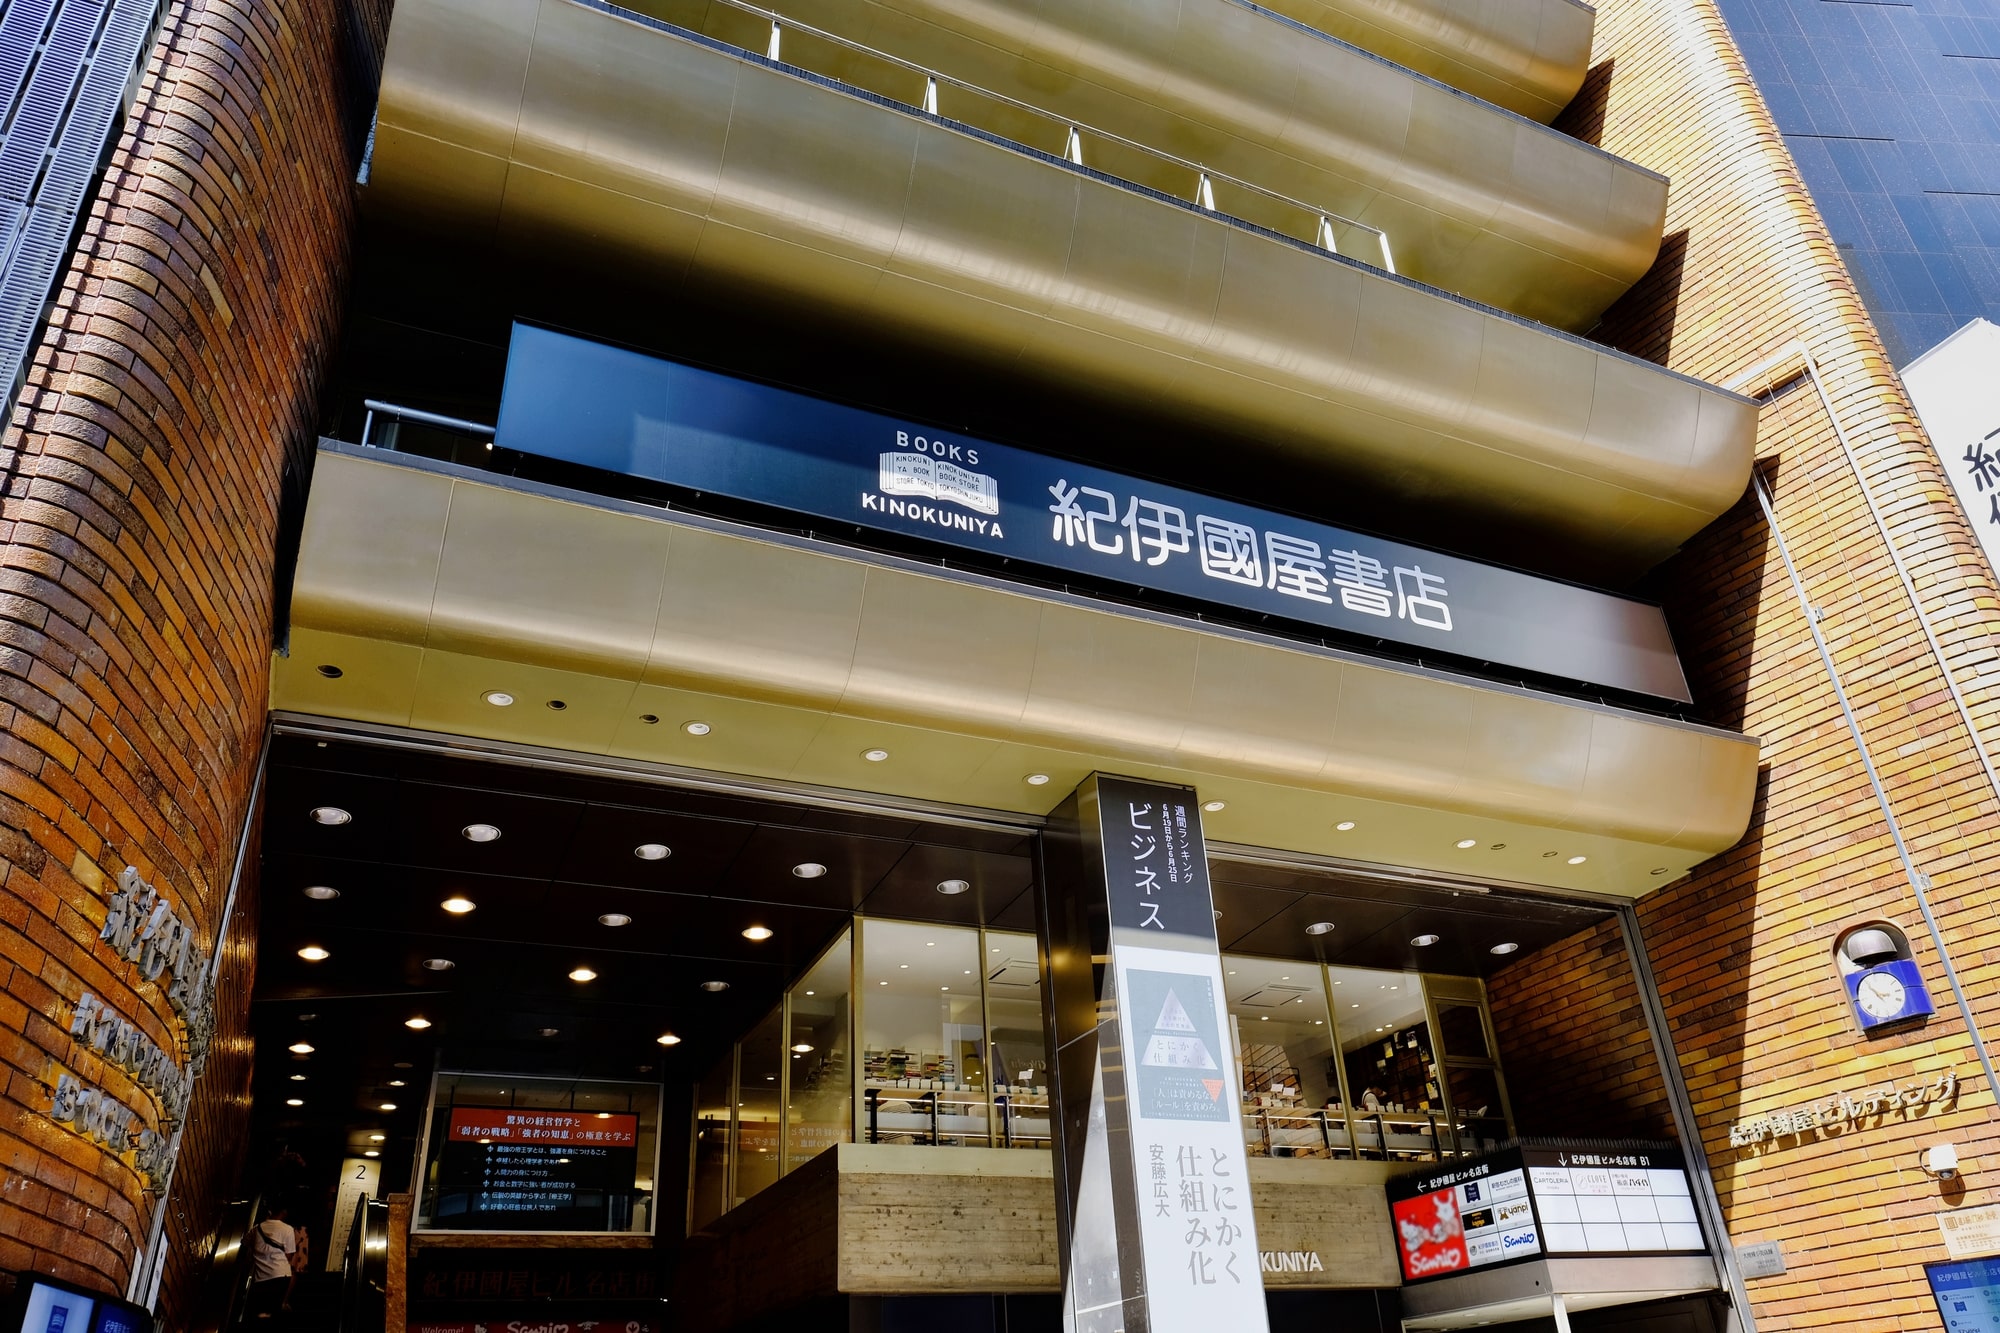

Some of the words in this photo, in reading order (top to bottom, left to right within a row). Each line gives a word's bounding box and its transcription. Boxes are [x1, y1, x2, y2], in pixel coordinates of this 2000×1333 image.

[896, 430, 979, 465] BOOKS
[896, 456, 931, 466] KINOKUNI
[913, 466, 930, 476] BOOK
[937, 462, 980, 483] KINOKUNIYA
[939, 472, 957, 483] BOOK
[958, 479, 979, 491] STORE
[862, 492, 1004, 538] KINOKUNIYA
[1047, 478, 1453, 631] 紀伊國屋書店
[1162, 803, 1178, 882] 6月19日から6月25日
[1174, 804, 1193, 883] 週間ランキング
[1129, 802, 1165, 930] ビジネス
[506, 1114, 581, 1128] 驚異の経営哲学と
[355, 1165, 366, 1179] 2
[1640, 1156, 1650, 1166] B1
[1149, 1144, 1170, 1218] 安藤広大
[1176, 1145, 1217, 1286] 仕組み化
[1210, 1147, 1242, 1284] とにかく
[1503, 1232, 1535, 1248] Sanrio
